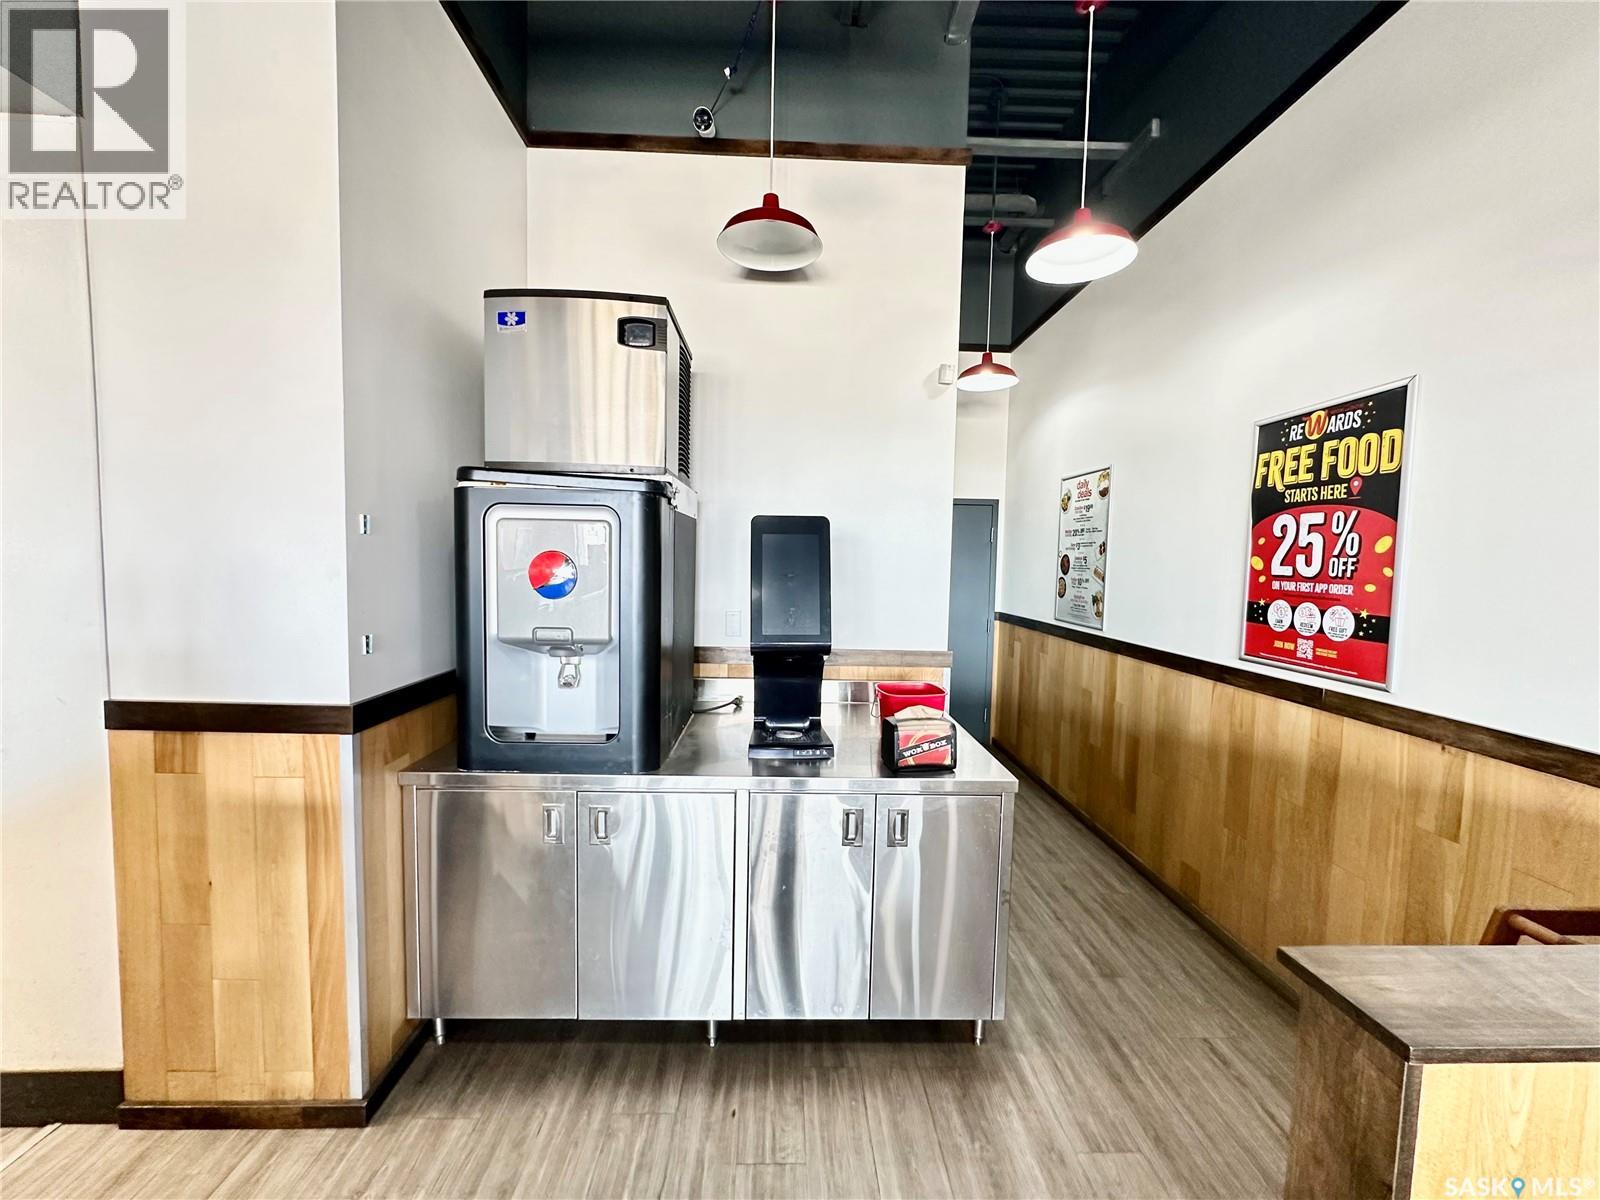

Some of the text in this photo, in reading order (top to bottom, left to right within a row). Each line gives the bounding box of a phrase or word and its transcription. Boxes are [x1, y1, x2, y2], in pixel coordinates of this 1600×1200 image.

[1289, 410, 1362, 442] REWARDS
[1255, 428, 1404, 493] FREE FOOD
[1284, 483, 1348, 503] STARTS HERE
[1328, 557, 1357, 578] OFF
[1271, 580, 1354, 596] ON YOUR FIRST APP ORDER
